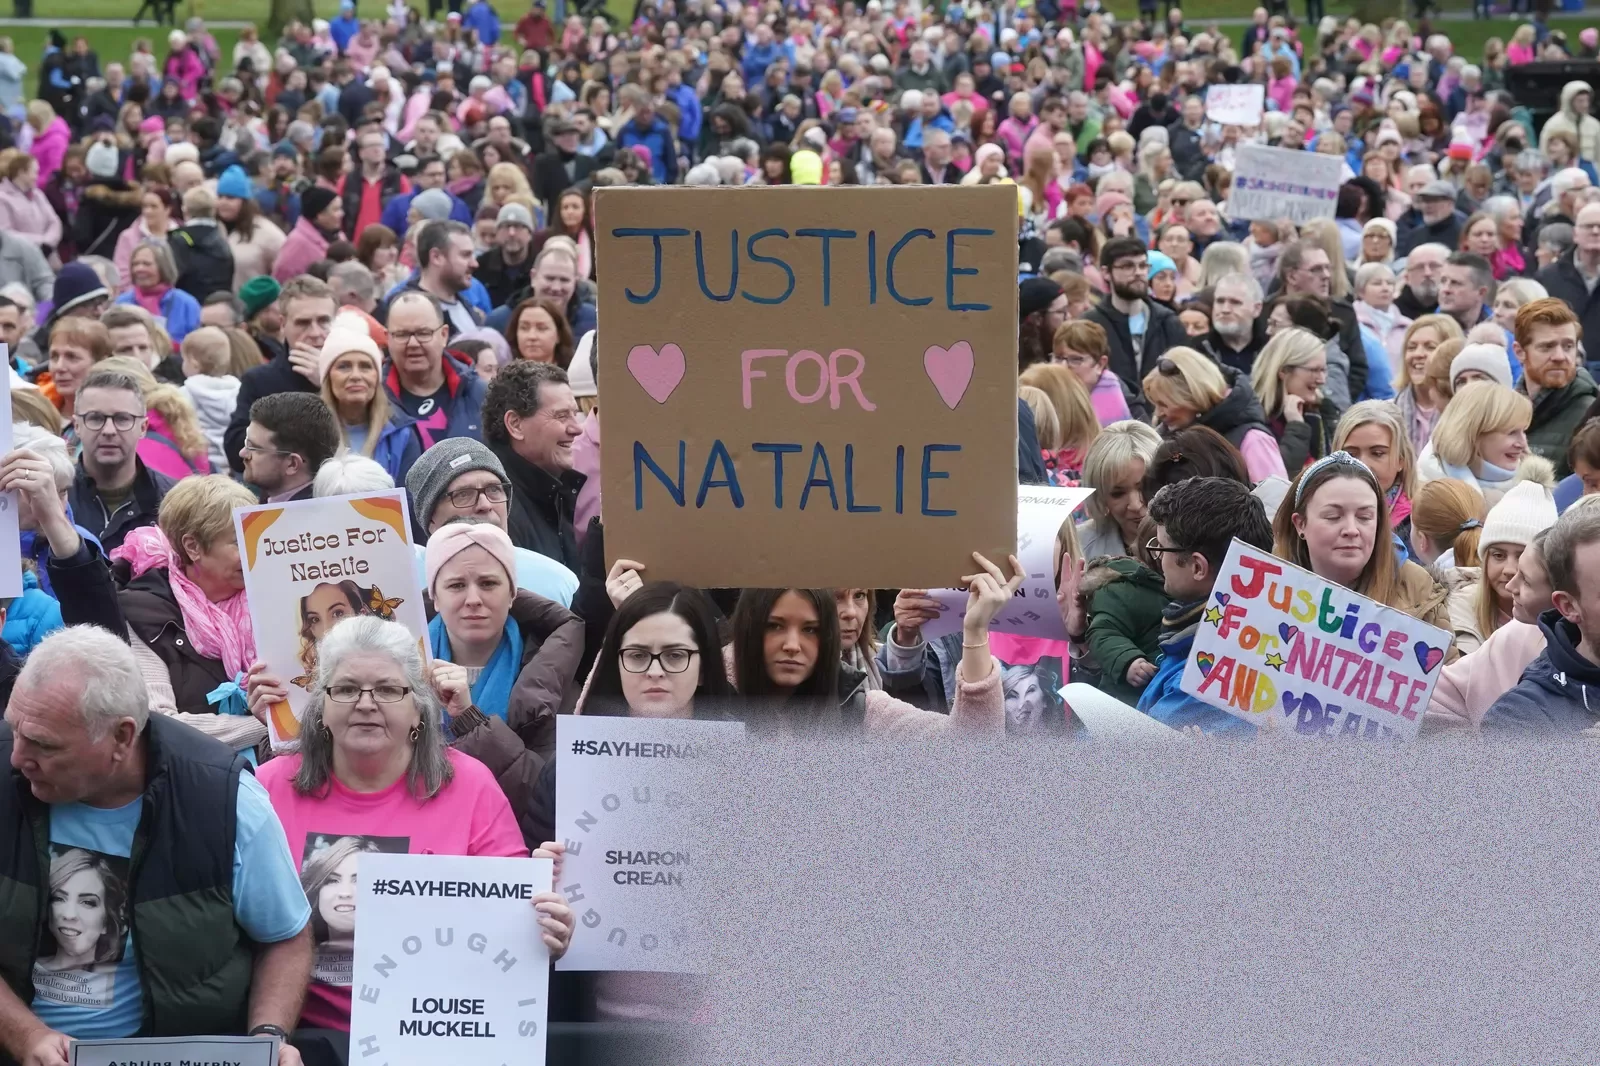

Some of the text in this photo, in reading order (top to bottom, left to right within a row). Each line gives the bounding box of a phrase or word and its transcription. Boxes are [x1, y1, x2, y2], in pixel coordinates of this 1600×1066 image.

[612, 228, 995, 311] JUSTICE
[741, 348, 877, 411] FOR
[633, 439, 962, 517] NATALIE
[1018, 495, 1071, 506] ERNAME
[263, 527, 387, 556] Justice For
[290, 556, 369, 582] Natalie
[1231, 555, 1409, 661] Justice
[1217, 604, 1428, 720] For NATALIE
[1197, 656, 1278, 713] AND
[605, 850, 691, 866] SHARON
[372, 879, 533, 900] #SAYHERNAME
[613, 871, 683, 886] CREAN
[358, 927, 518, 1004] ENOUGH
[412, 998, 485, 1015] LOUISE
[399, 1020, 496, 1038] MUCKELL
